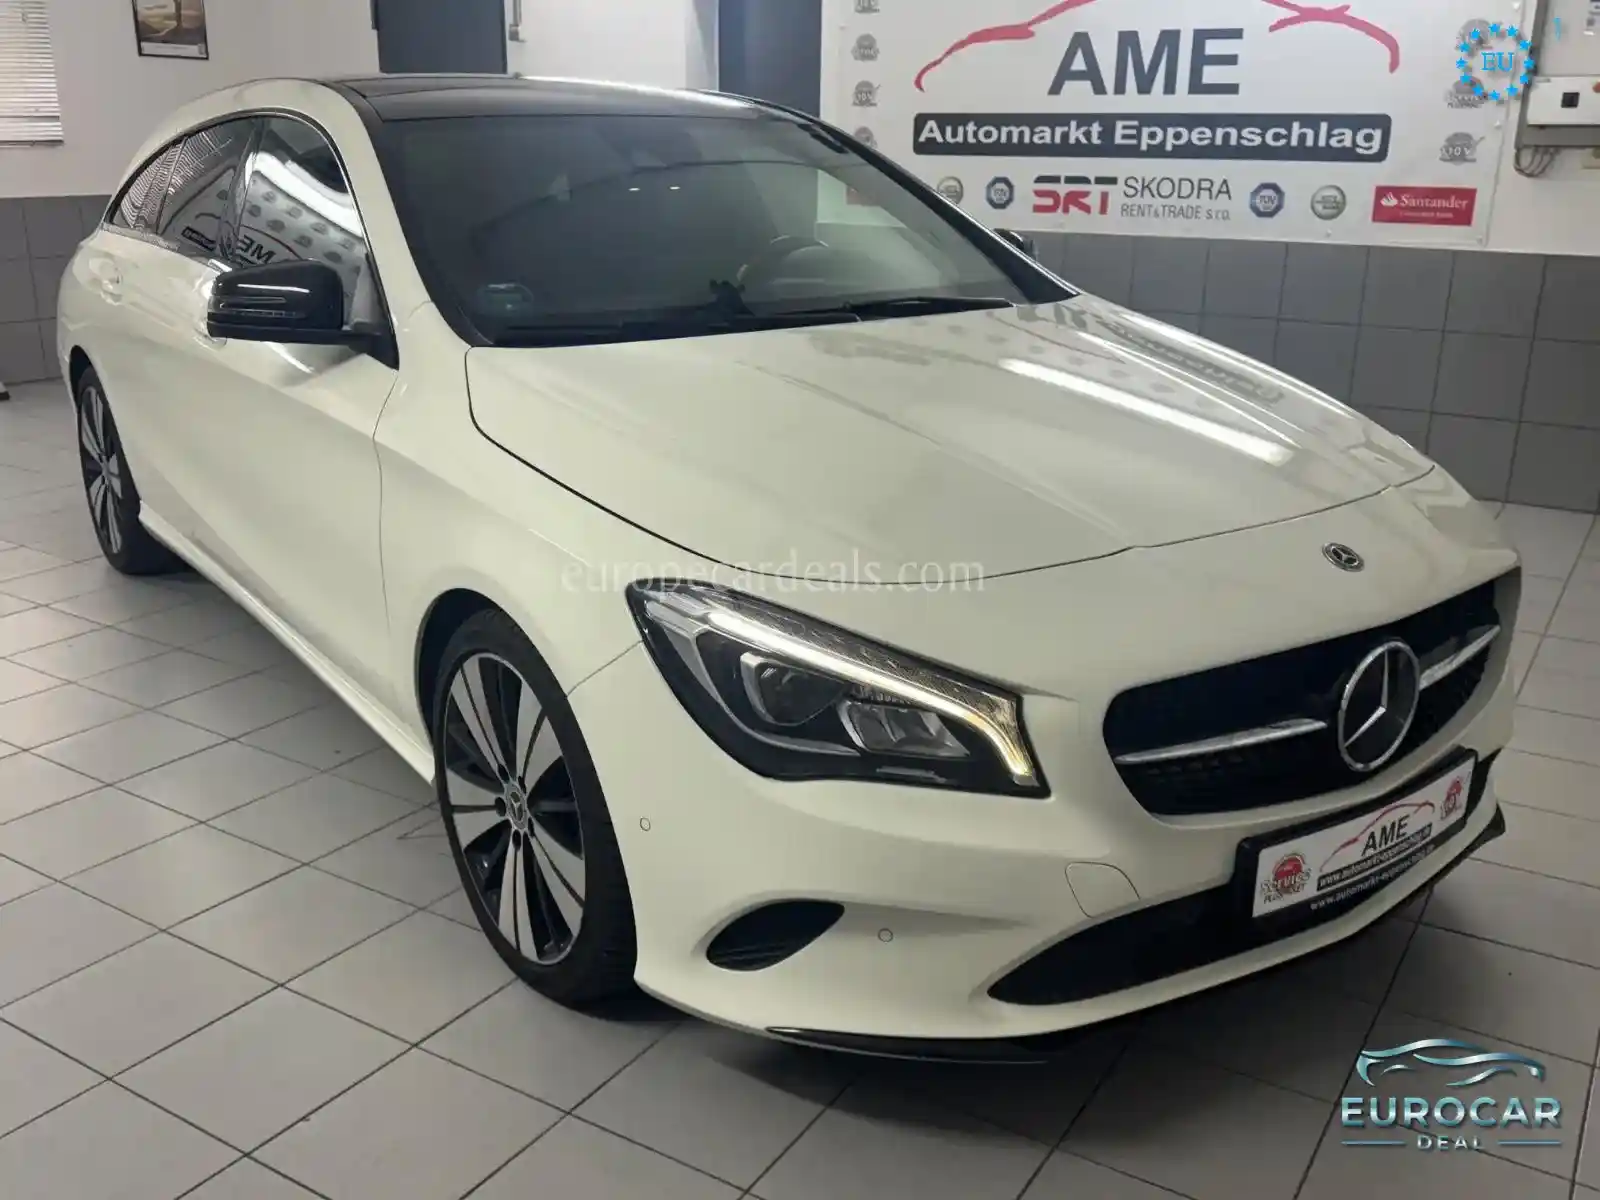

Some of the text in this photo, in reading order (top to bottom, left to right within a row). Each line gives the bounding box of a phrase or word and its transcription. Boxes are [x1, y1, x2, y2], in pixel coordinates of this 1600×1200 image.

[1047, 27, 1244, 96] AME
[917, 119, 1384, 155] Automarkt Eppenschlag
[1032, 175, 1119, 216] SRT
[1122, 175, 1233, 201] SKODRA
[1400, 192, 1469, 211] Santander
[1361, 813, 1410, 857] AME
